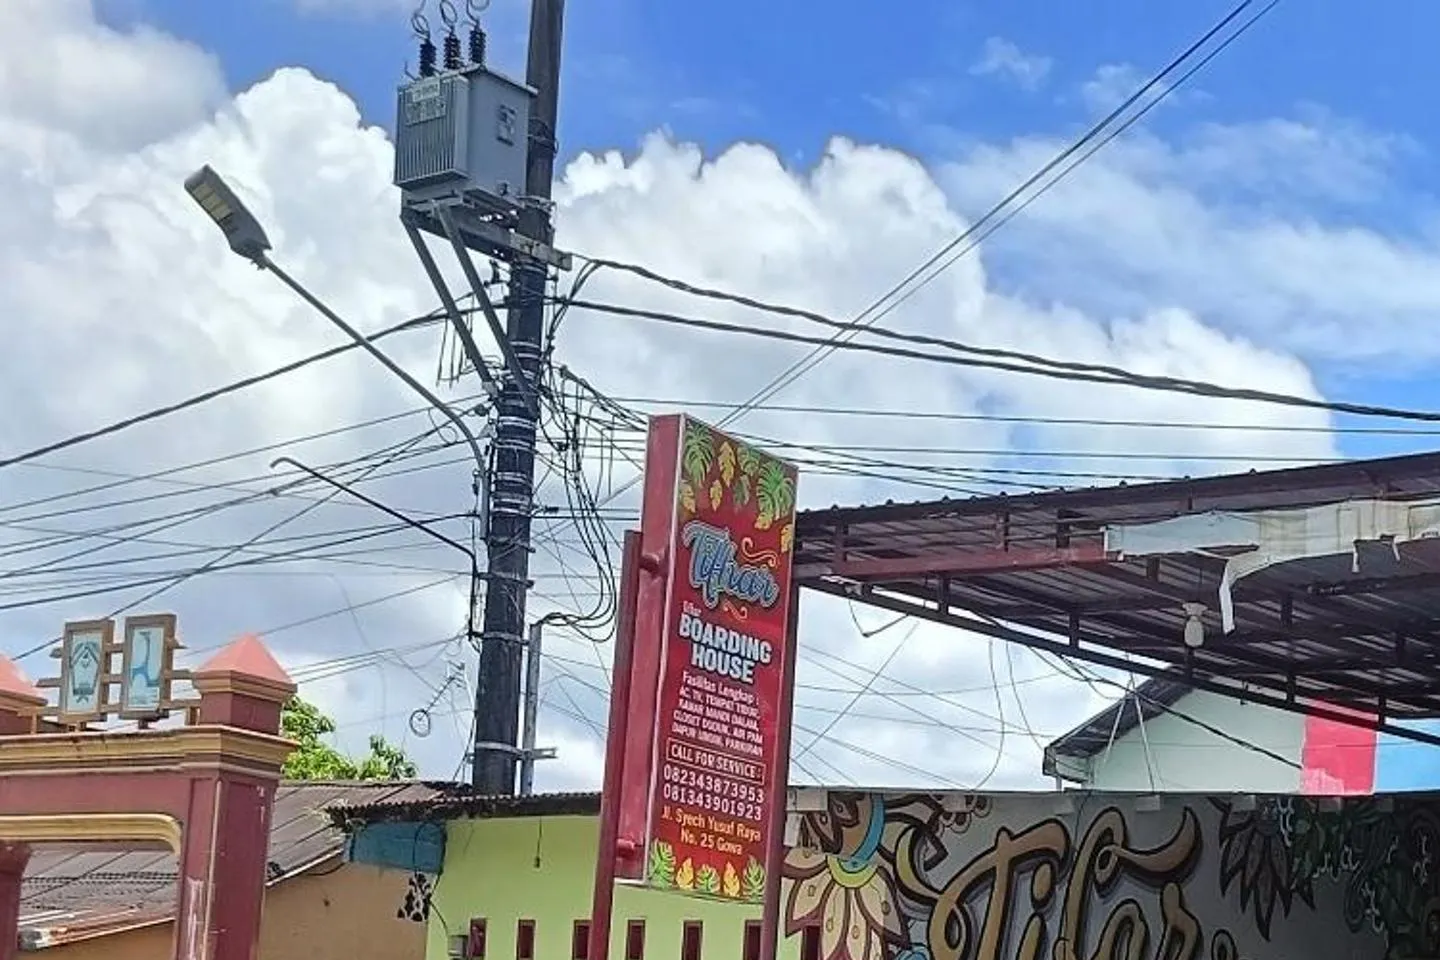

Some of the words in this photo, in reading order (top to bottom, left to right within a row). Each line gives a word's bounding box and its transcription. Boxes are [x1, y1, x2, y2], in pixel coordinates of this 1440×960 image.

[679, 613, 773, 664] BOARDING
[691, 643, 756, 685] HOUSE
[682, 670, 717, 693] Fasilitas
[718, 682, 754, 705] Lengkap
[671, 743, 693, 763] CALL
[694, 751, 714, 768] FOR
[715, 756, 755, 779] SERVICE
[663, 763, 764, 804] 082343873953
[663, 782, 762, 821] 081343901923
[675, 807, 706, 829] Syech
[707, 815, 735, 837] Yusuf
[736, 823, 761, 843] Raya
[700, 832, 715, 850] 25
